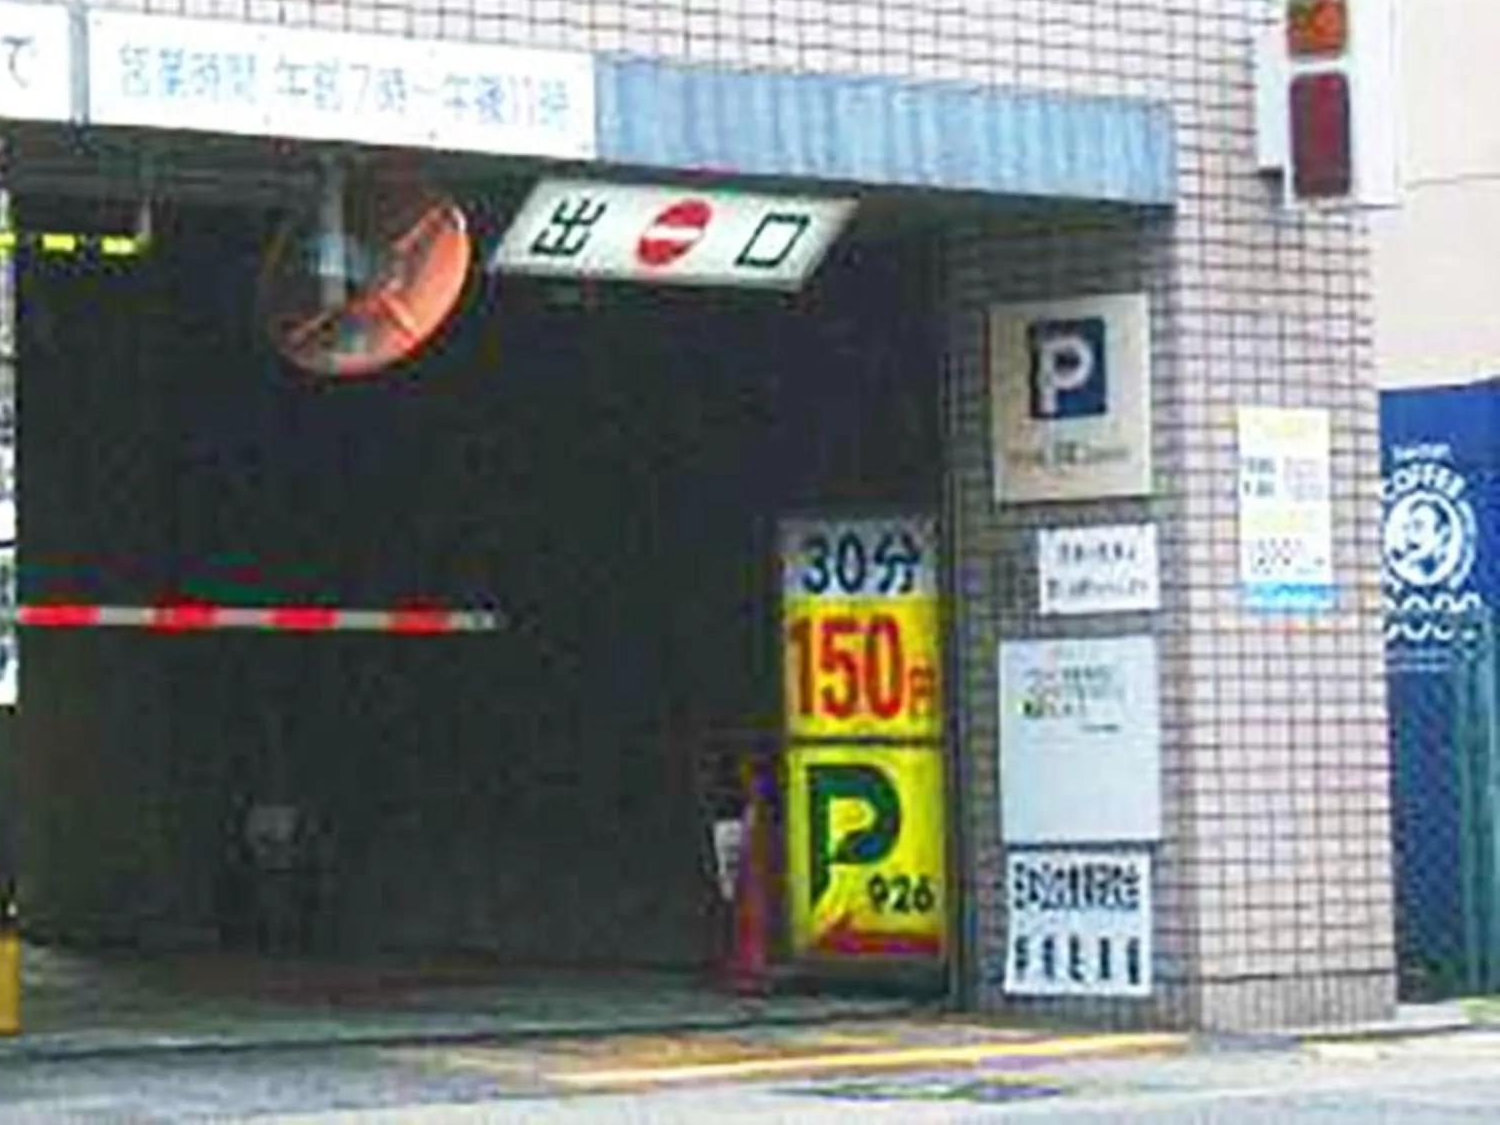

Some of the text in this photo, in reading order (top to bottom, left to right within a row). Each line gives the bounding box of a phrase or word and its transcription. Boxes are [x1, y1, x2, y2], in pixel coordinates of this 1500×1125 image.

[1038, 335, 1094, 415] P
[801, 532, 921, 595] 30分
[786, 613, 936, 720] 150円
[804, 761, 902, 909] P
[868, 875, 935, 915] 926
